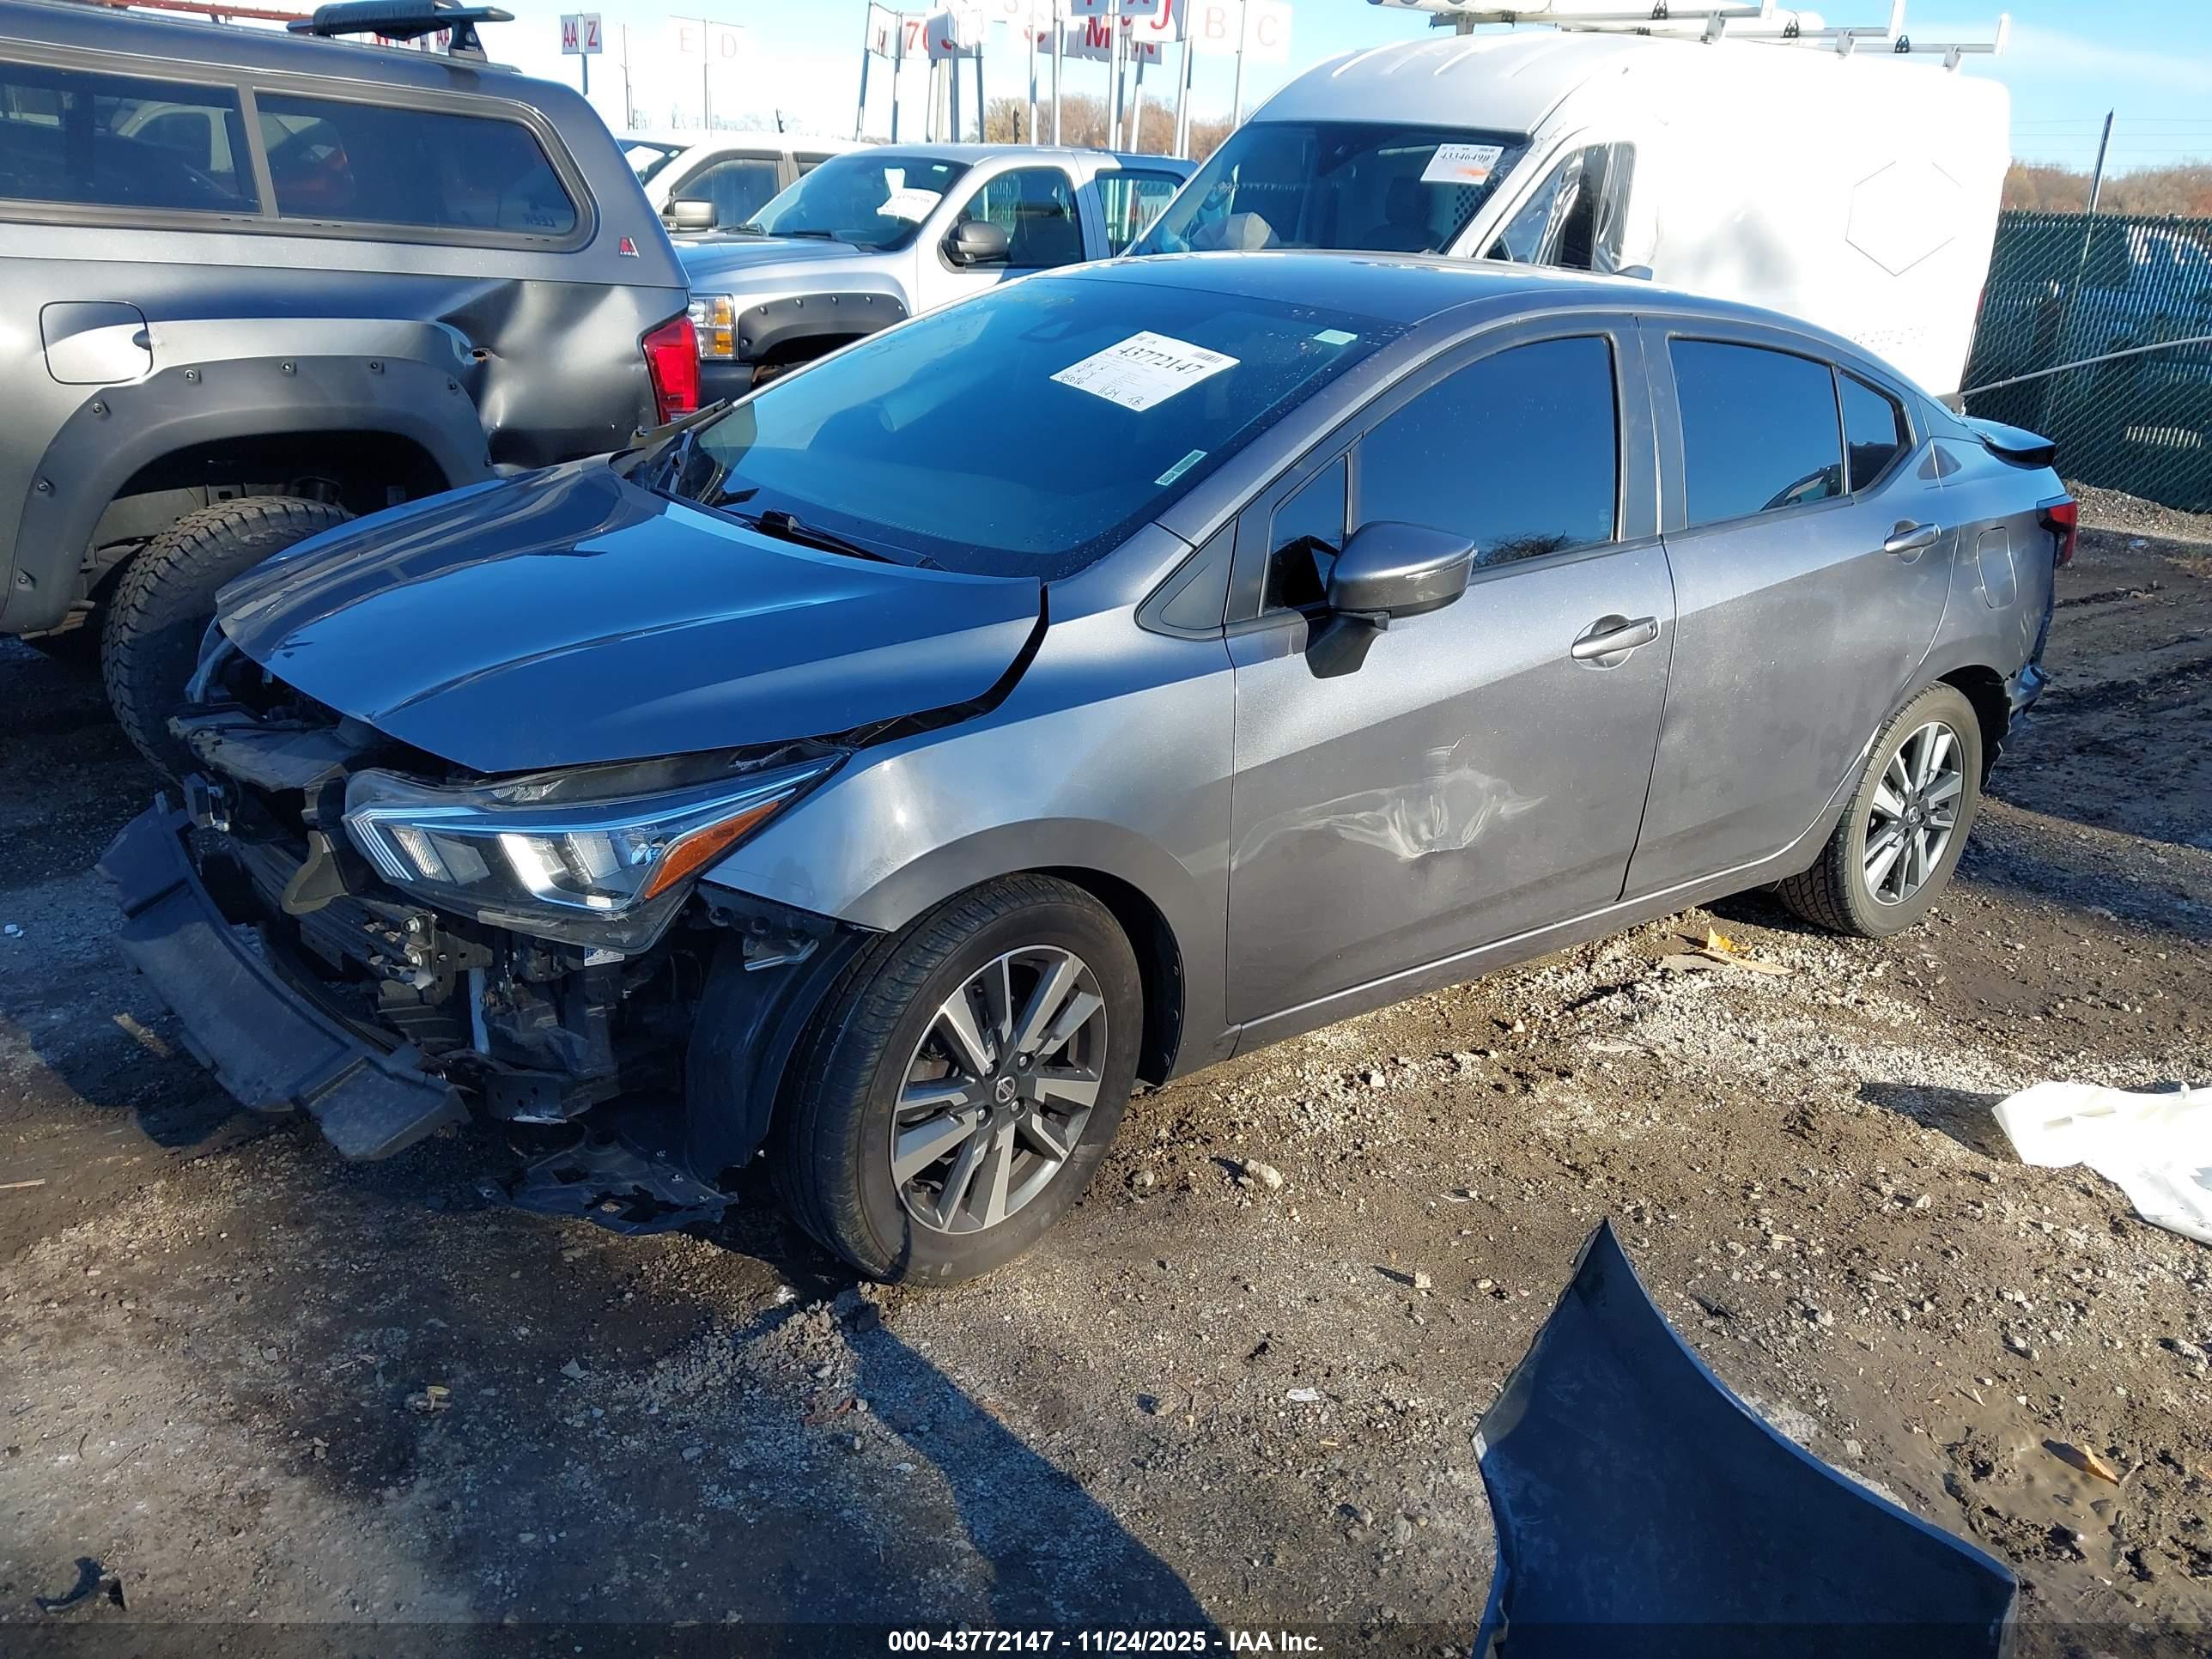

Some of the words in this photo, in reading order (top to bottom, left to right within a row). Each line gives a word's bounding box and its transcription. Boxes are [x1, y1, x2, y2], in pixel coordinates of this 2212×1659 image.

[562, 21, 578, 48] AA
[587, 20, 599, 47] Z
[1085, 15, 1111, 49] M
[1205, 6, 1226, 40] B
[1256, 15, 1279, 46] C
[679, 27, 695, 53] E
[720, 33, 737, 58] D
[1118, 345, 1206, 375] 43772147
